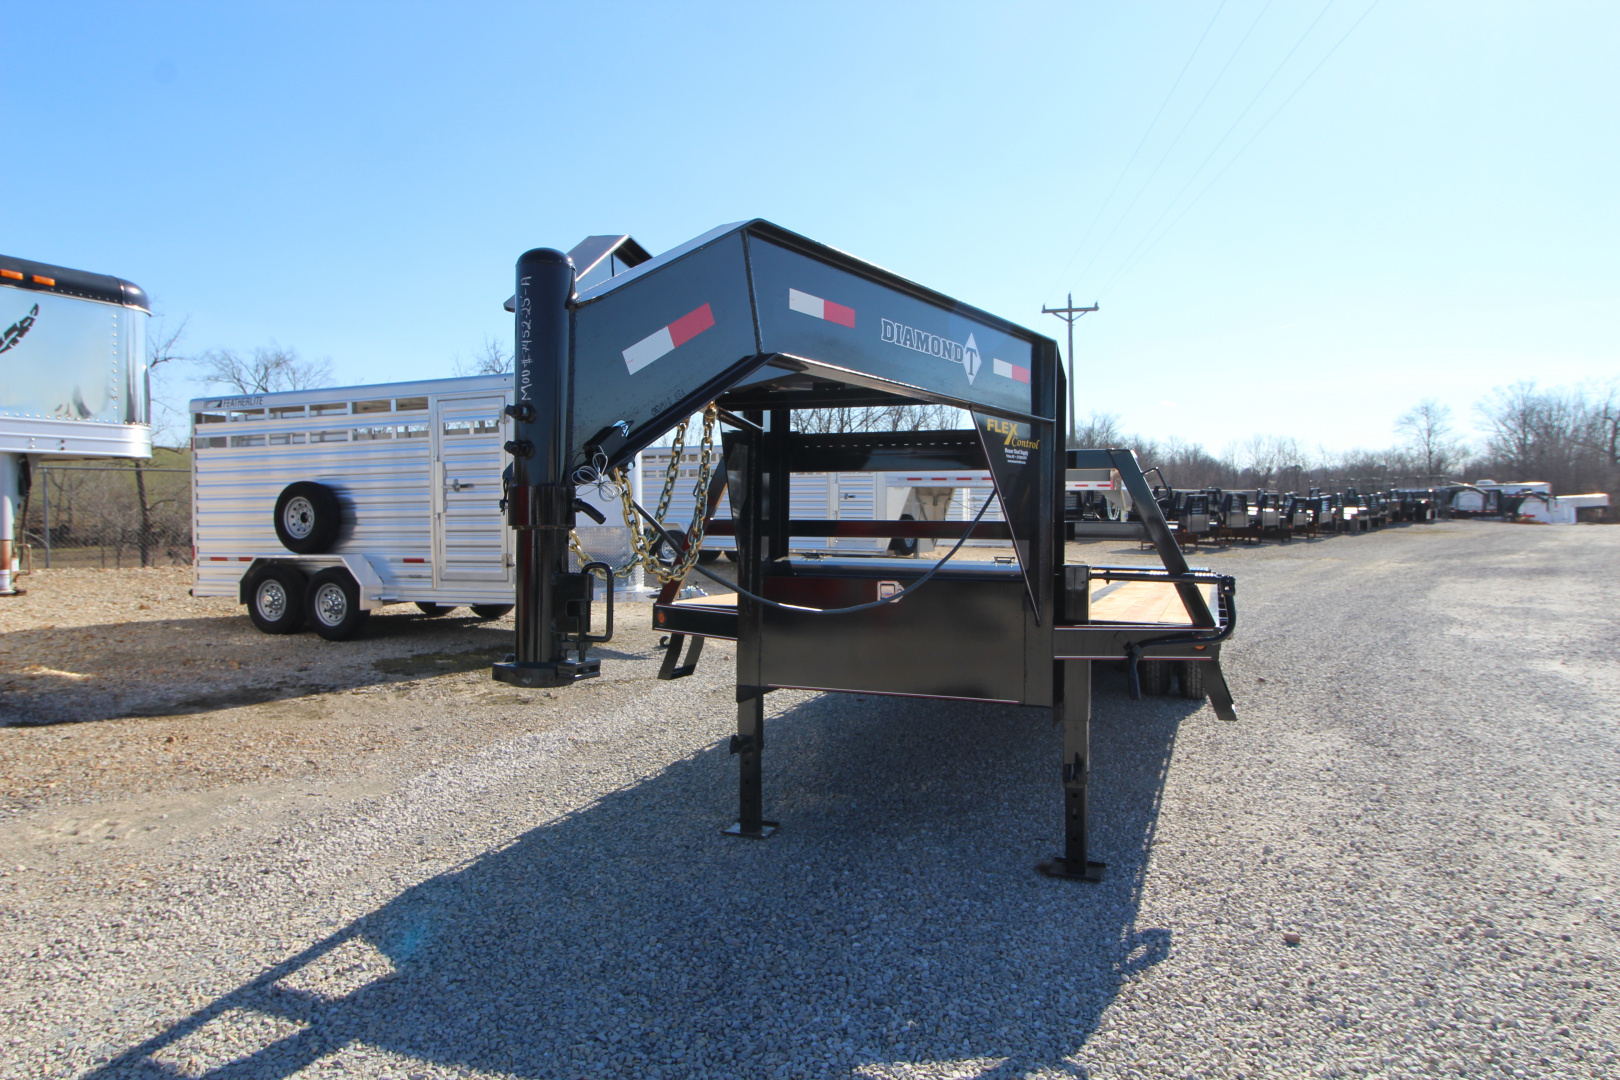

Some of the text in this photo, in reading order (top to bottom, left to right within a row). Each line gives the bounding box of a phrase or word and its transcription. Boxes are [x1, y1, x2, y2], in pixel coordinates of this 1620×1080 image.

[881, 318, 978, 376] DIAMOND T
[223, 396, 264, 408] FEATHERLITE
[987, 418, 1018, 445] FLEX
[1011, 436, 1040, 449] Control
